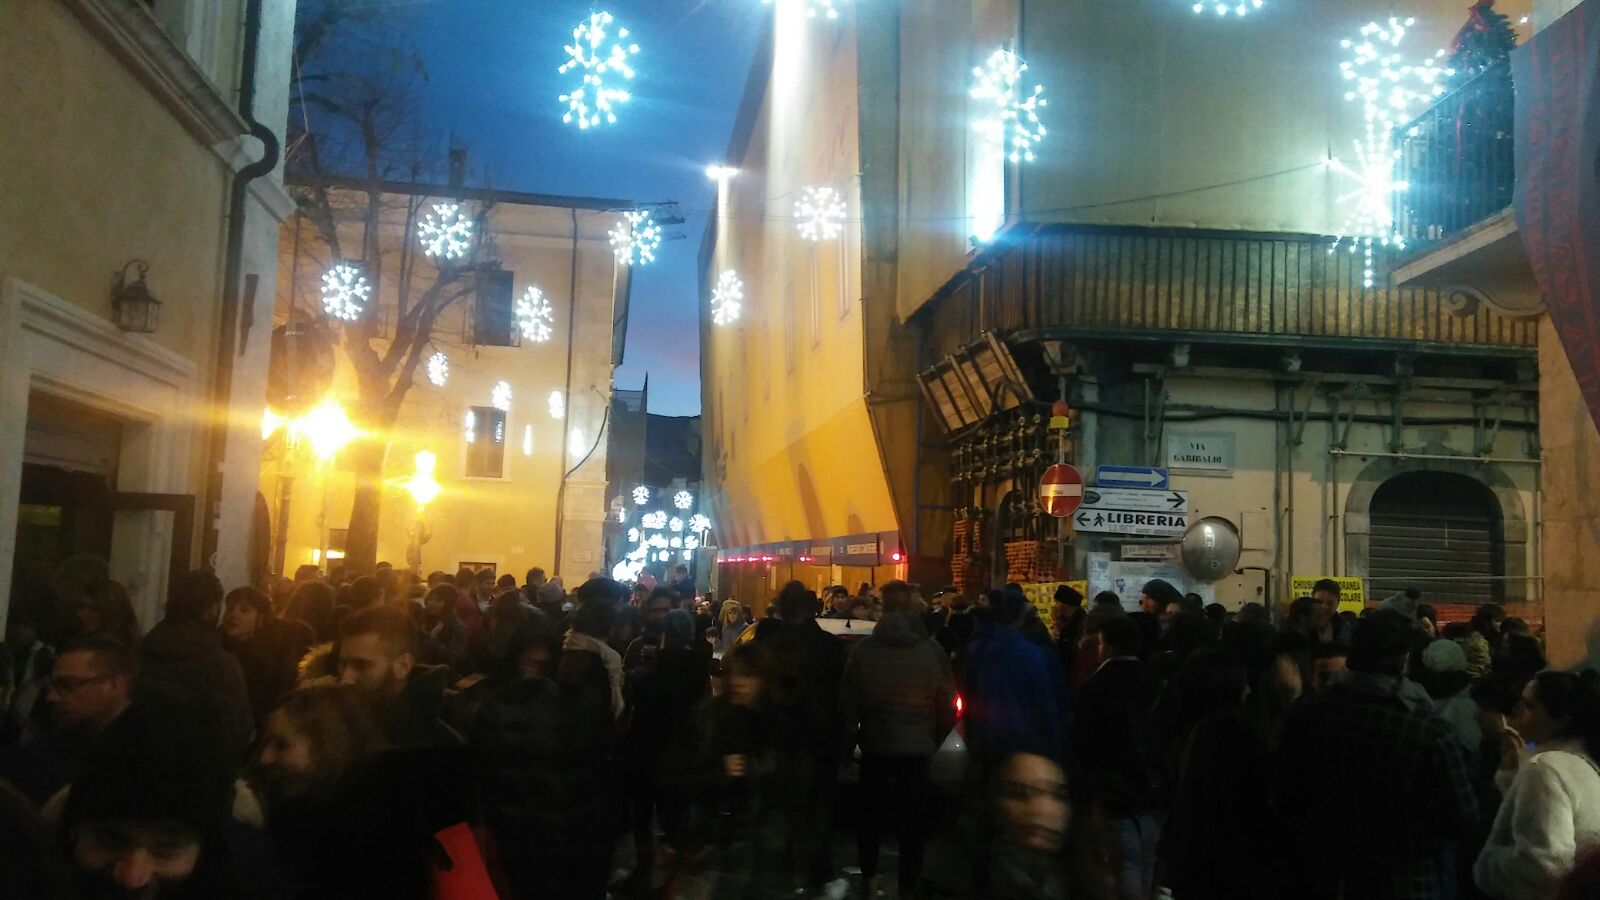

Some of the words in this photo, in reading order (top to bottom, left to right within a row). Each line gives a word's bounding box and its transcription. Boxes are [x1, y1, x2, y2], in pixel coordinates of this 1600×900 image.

[1189, 442, 1206, 451] VIA
[1173, 454, 1222, 464] GARIBALDI
[1107, 512, 1186, 527] LIBRERIA
[1338, 581, 1361, 591] ORANEA
[1340, 592, 1362, 602] COLARE
